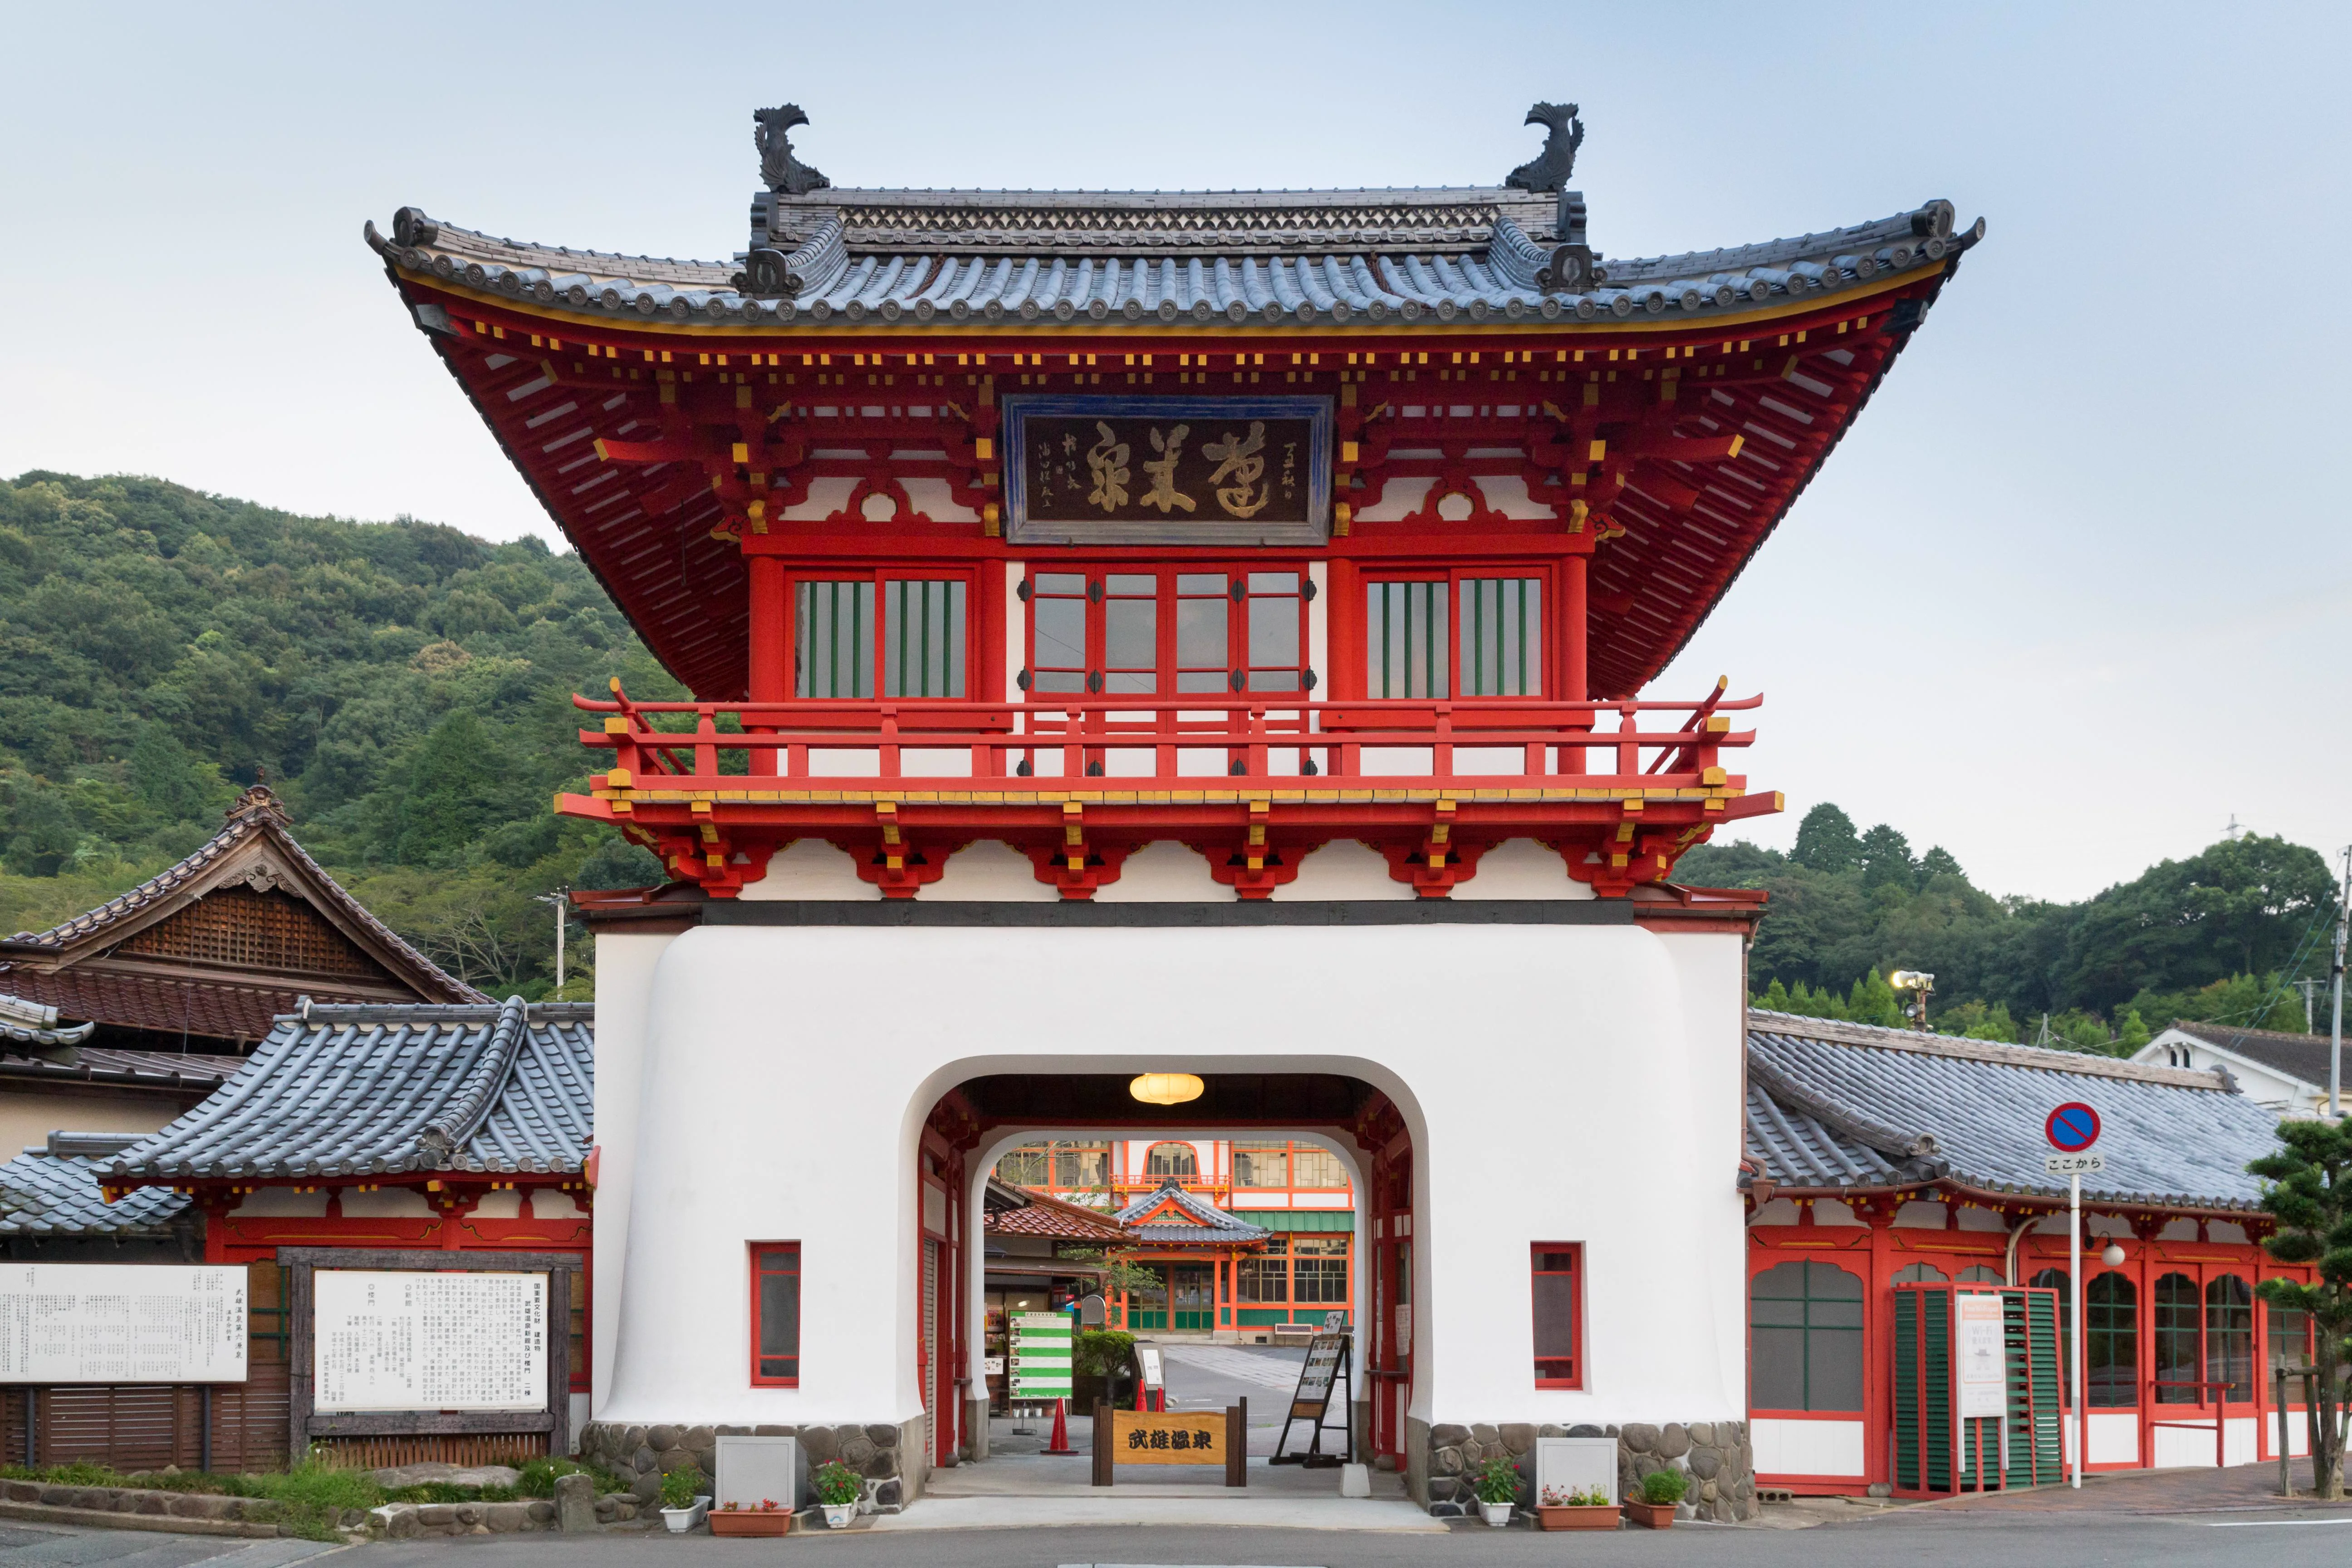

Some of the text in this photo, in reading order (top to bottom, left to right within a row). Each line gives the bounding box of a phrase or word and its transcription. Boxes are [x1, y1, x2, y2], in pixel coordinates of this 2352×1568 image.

[2049, 1157, 2101, 1170] ここから
[235, 1288, 244, 1359] 武雄温泉第六源泉
[1971, 1325, 1993, 1335] Wi-Fi
[524, 1382, 531, 1396] 二棟
[1128, 1429, 1213, 1450] 武雄温泉
